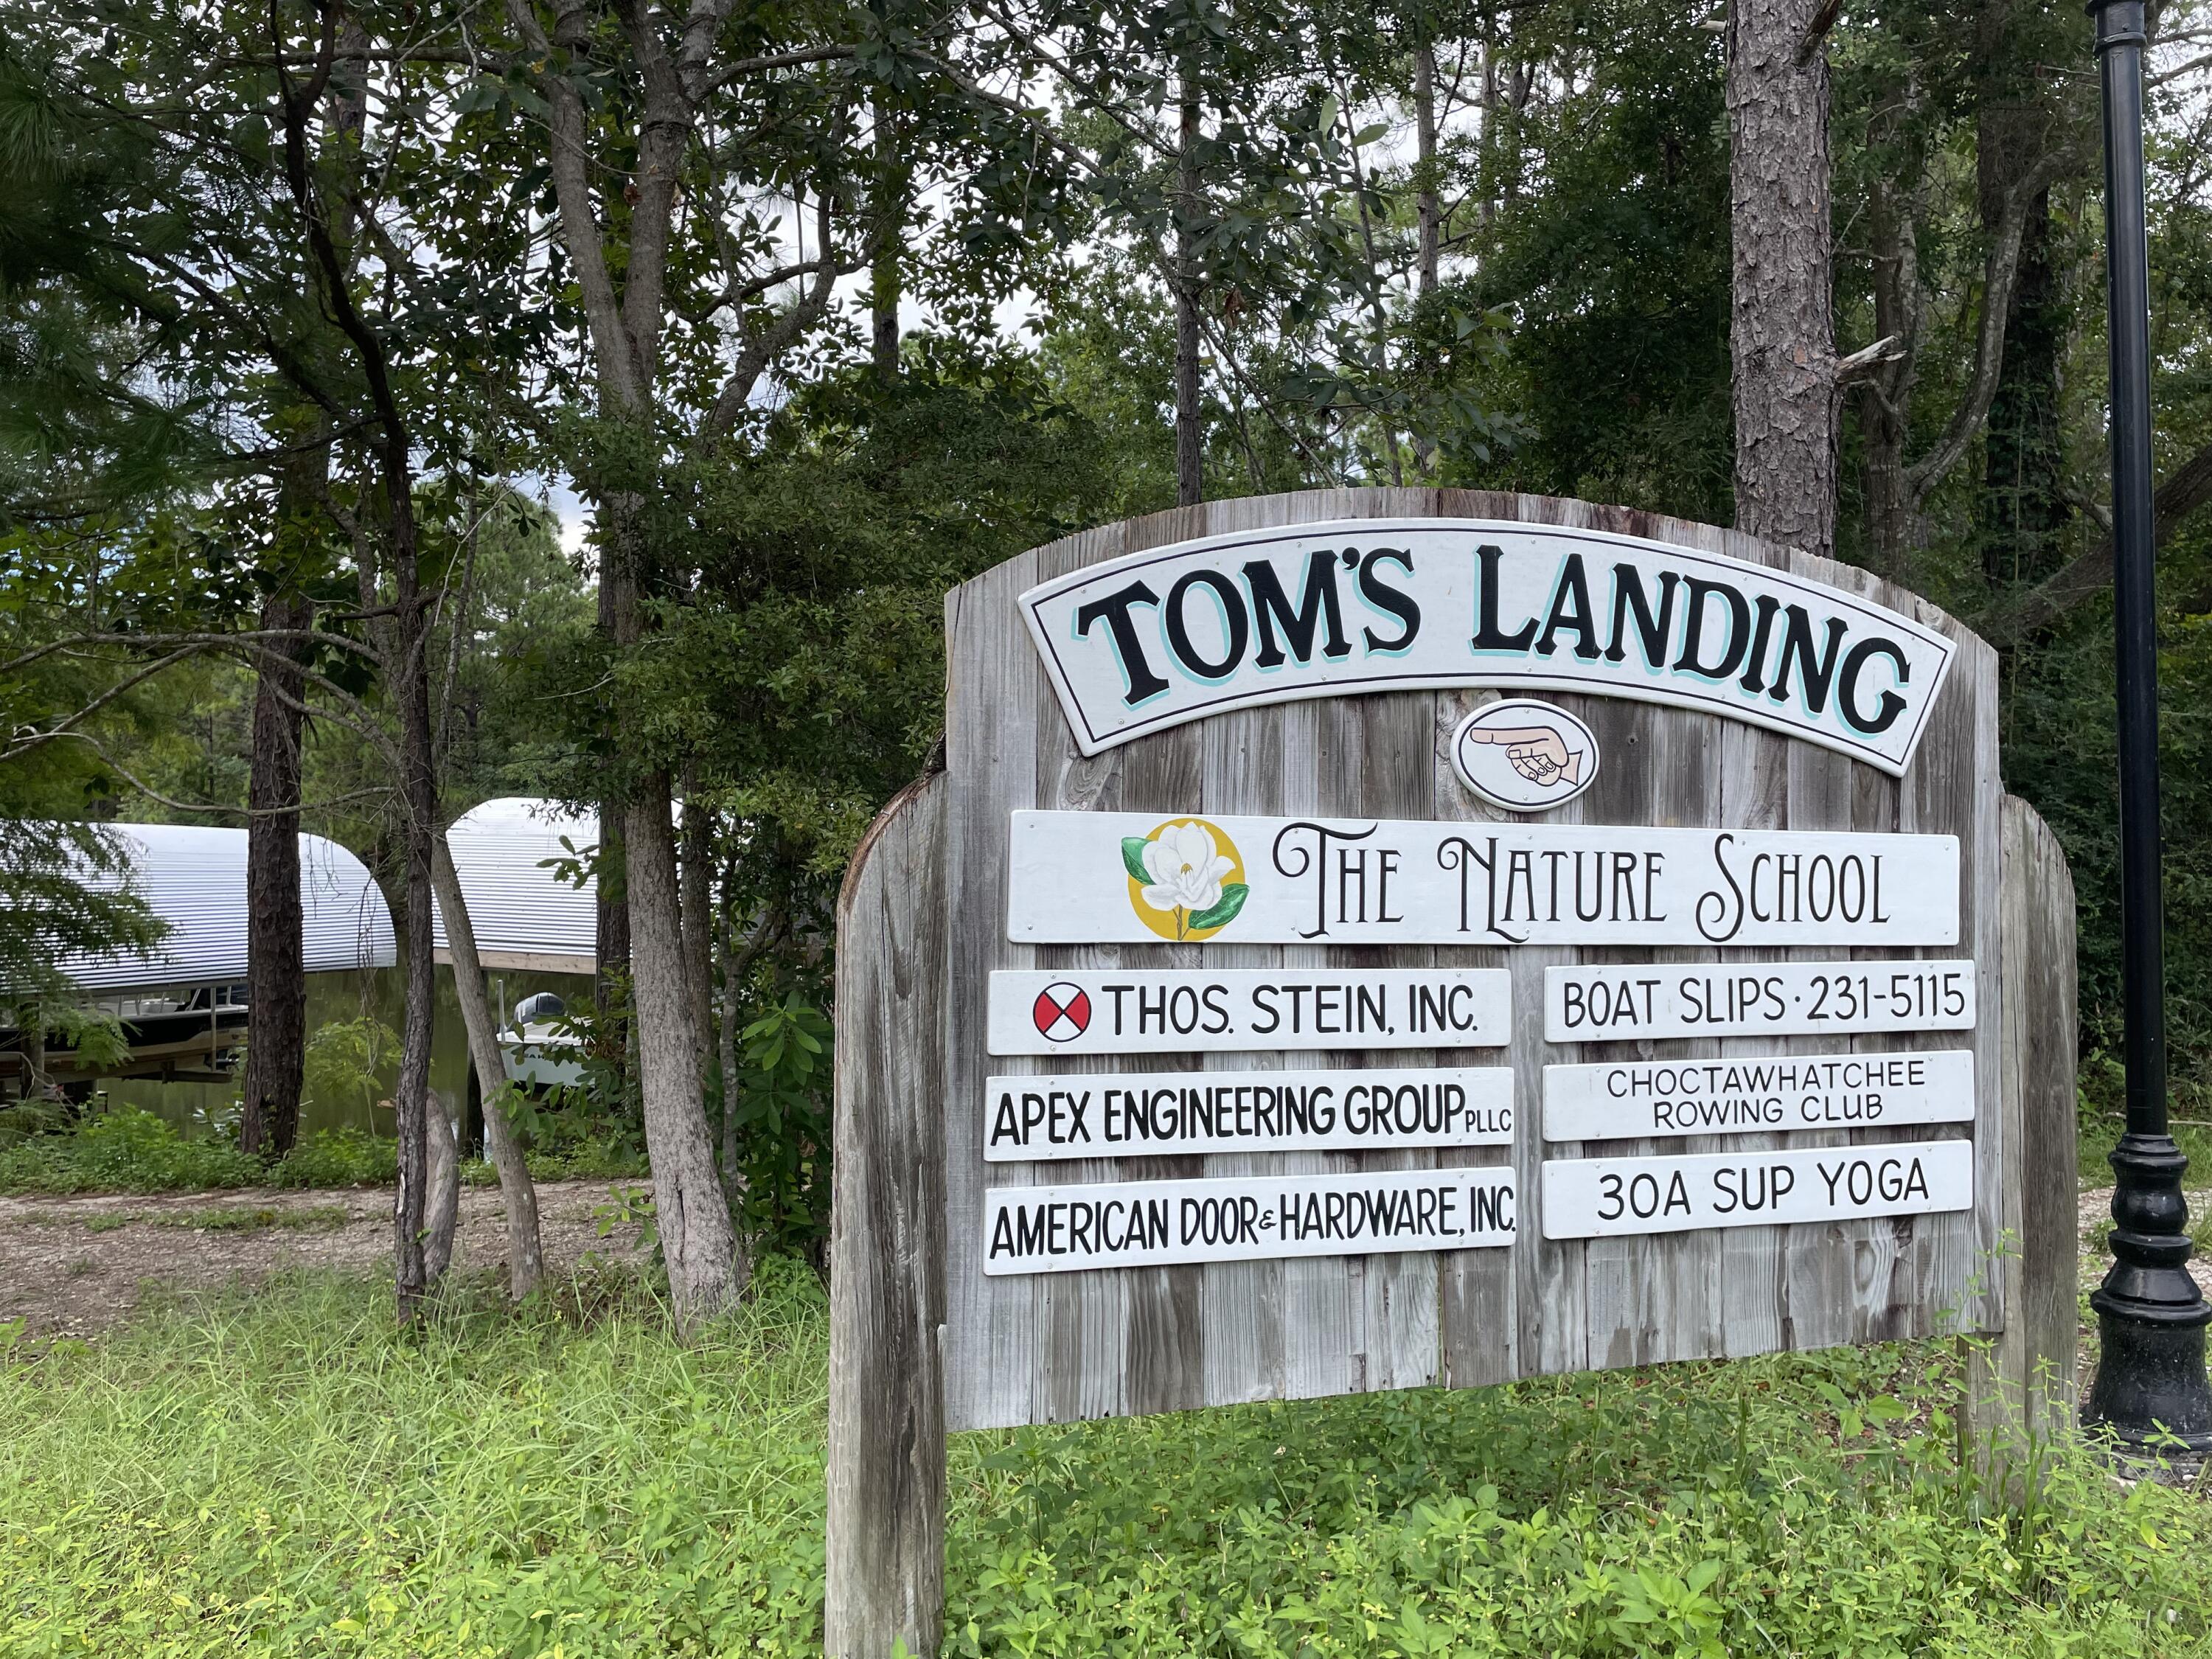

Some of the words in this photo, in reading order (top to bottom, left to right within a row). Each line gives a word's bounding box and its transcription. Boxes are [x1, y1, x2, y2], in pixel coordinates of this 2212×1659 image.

[1069, 547, 1423, 712] TOM'S
[1467, 544, 1911, 740] LANDING
[1271, 821, 1405, 939] THE
[1436, 835, 1669, 944] NATURE
[1694, 832, 1892, 943] SCHOOL
[1100, 983, 1234, 1037] THOS.
[1251, 983, 1395, 1037] STEIN,
[1408, 983, 1479, 1034] INC.
[1563, 979, 1662, 1029] BOAT
[1679, 976, 1786, 1025] SLIPS
[1806, 973, 1966, 1020] 231-5115
[1606, 1060, 1927, 1099] CHOCTAWHATCHEE
[1653, 1096, 1784, 1130] ROWING
[1800, 1093, 1884, 1124] CLUB
[990, 1089, 1092, 1147] APEX
[1104, 1085, 1334, 1142] ENGINEERING
[1343, 1083, 1465, 1137] GROUP
[1464, 1107, 1512, 1134] PLLC
[1596, 1170, 1691, 1221] 30A
[1712, 1165, 1795, 1214] SUP
[1816, 1157, 1930, 1206] YOGA
[991, 1197, 1169, 1260] AMERICAN
[1180, 1195, 1259, 1246] DOOR
[1258, 1208, 1277, 1230] &
[1279, 1186, 1466, 1242] HARDWARE,
[1470, 1184, 1517, 1234] INC.
